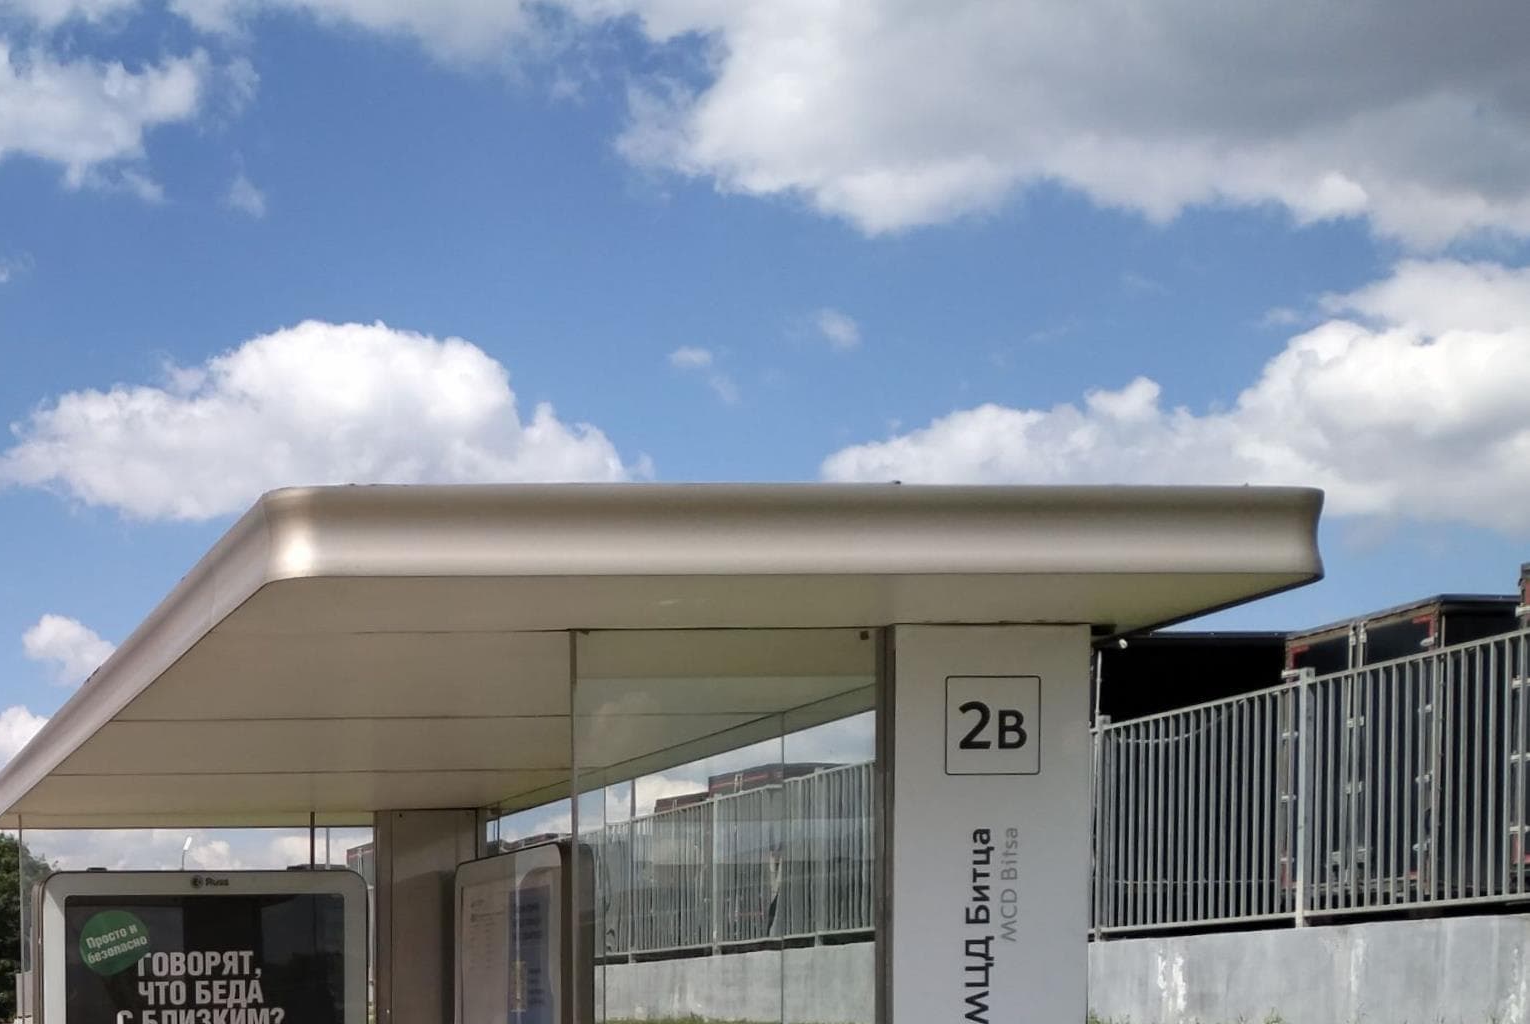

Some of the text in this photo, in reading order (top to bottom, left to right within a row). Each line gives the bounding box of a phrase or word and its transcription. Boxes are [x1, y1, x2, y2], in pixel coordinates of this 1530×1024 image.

[964, 827, 996, 925] Битца
[1000, 826, 1019, 943] MCD Bitsa
[86, 929, 128, 950] Просто
[88, 935, 149, 965] безопасно
[137, 951, 263, 978] ГОВОРЯТ,
[138, 979, 265, 1009] ЧТО БЕДА
